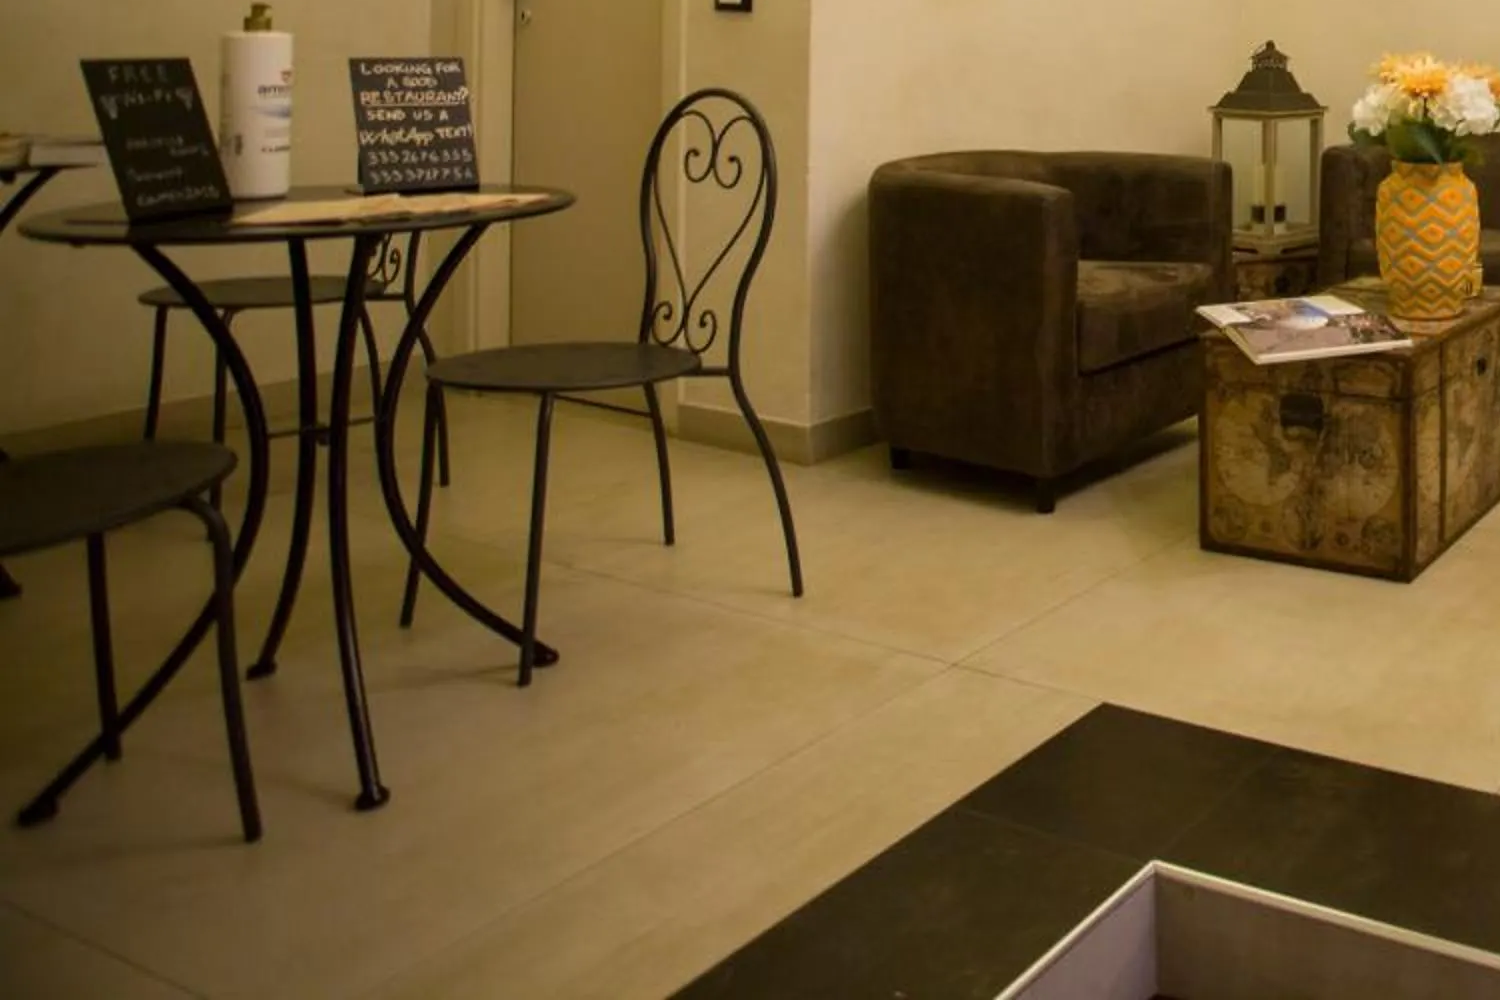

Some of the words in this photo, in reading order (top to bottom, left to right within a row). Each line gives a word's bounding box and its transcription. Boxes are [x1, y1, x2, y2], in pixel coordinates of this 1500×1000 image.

[360, 62, 432, 75] LOOKING
[435, 61, 461, 73] FOR
[387, 77, 398, 88] A
[402, 76, 438, 88] GOOD
[366, 109, 406, 121] SEND
[412, 110, 433, 121] US
[439, 109, 449, 121] A
